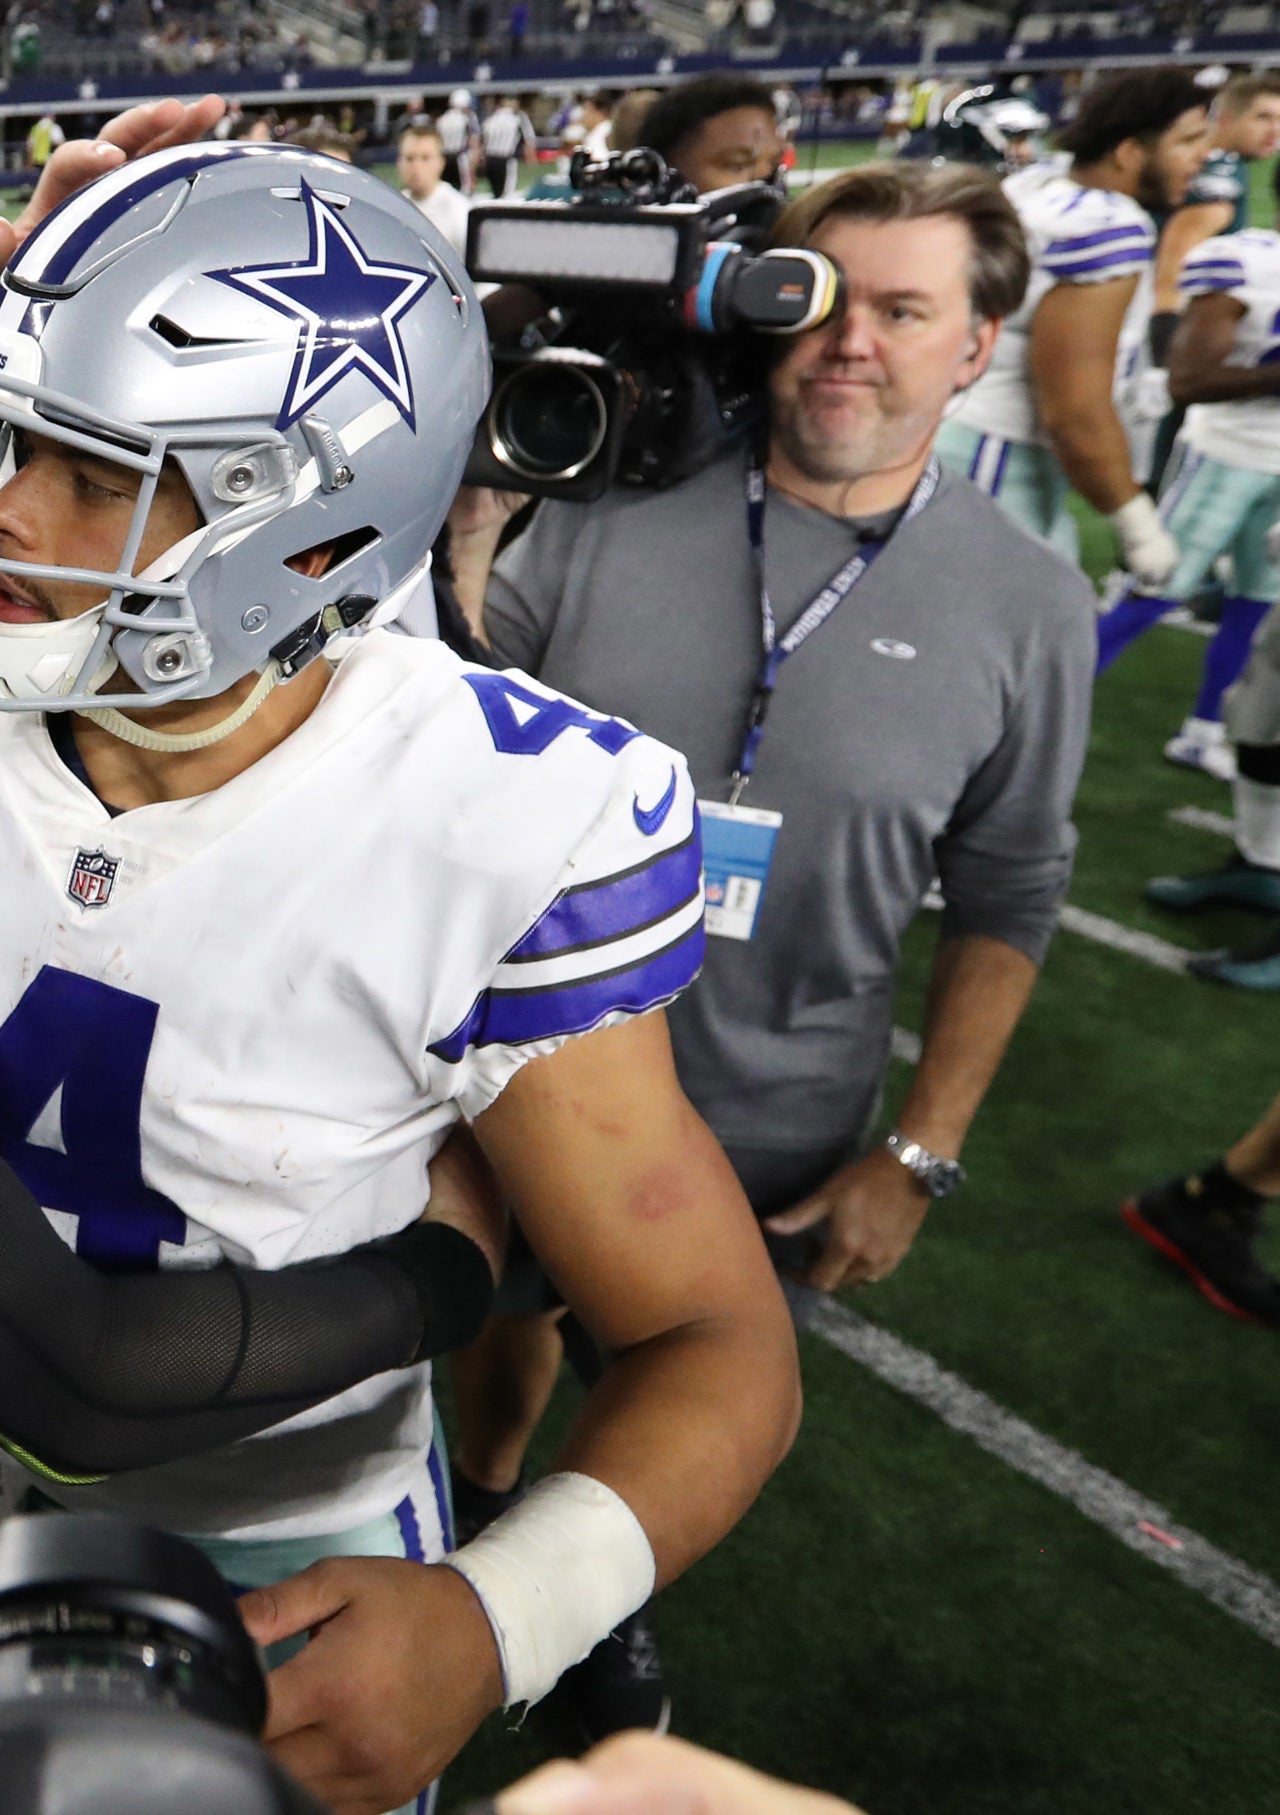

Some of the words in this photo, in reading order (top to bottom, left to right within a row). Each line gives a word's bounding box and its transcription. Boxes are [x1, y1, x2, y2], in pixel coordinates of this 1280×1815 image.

[779, 587, 842, 653] STADIUM
[461, 672, 645, 756] 4
[72, 870, 109, 902] NFL
